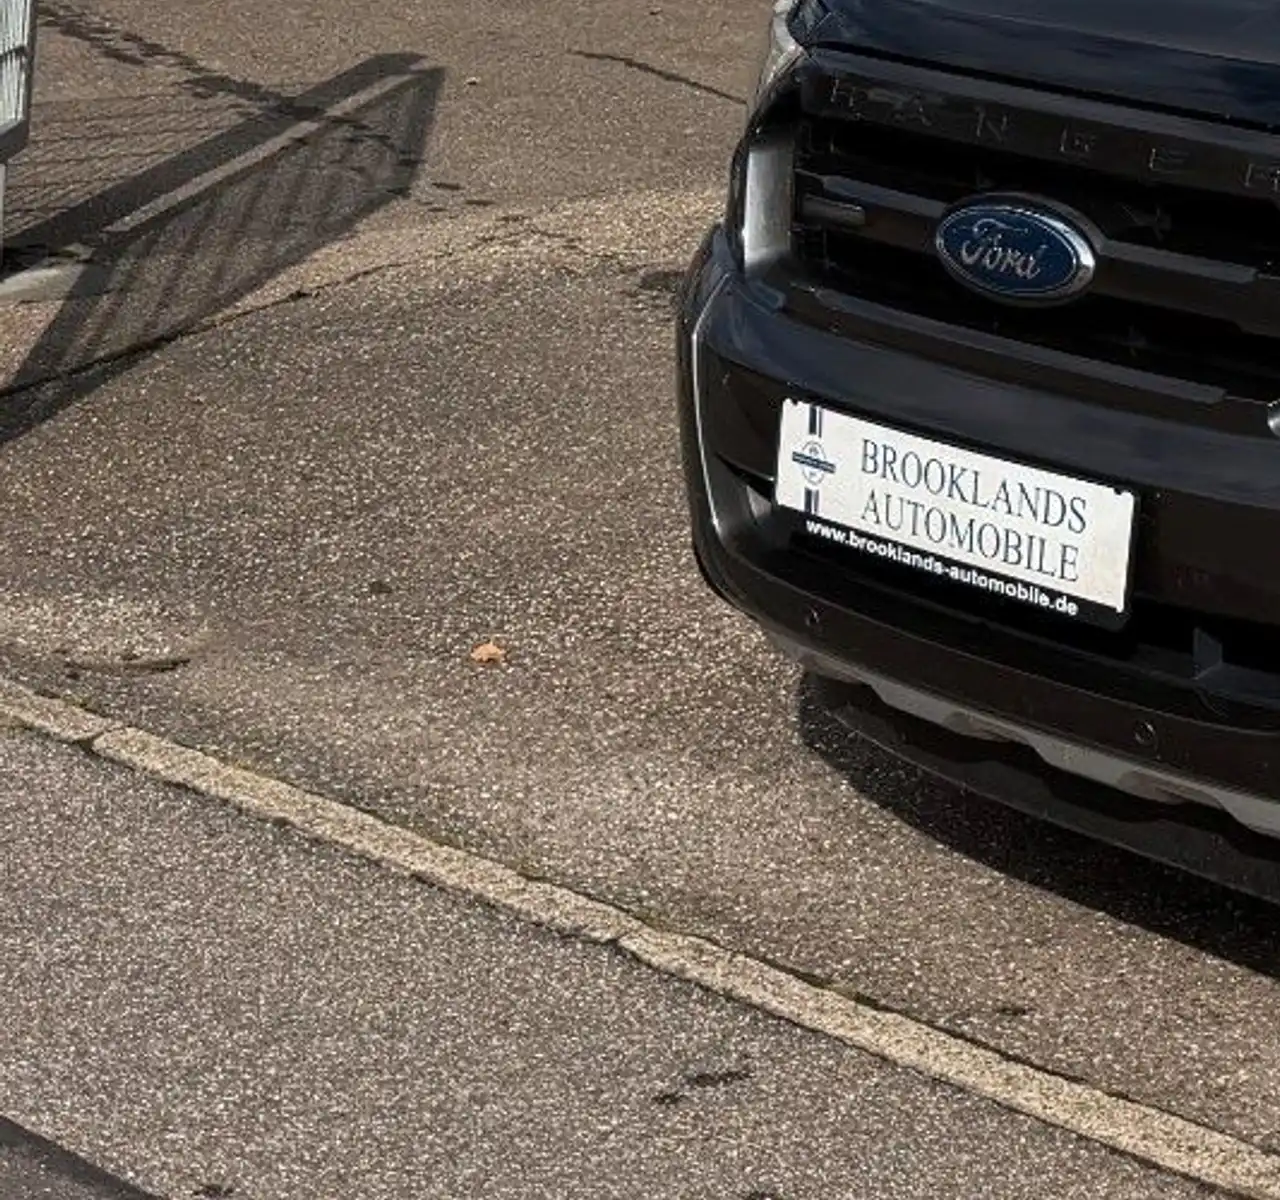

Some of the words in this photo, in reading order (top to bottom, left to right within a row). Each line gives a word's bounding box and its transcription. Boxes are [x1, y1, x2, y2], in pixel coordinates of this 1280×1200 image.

[953, 217, 1049, 280] Ford
[860, 438, 1088, 534] BROOKLANDS
[805, 518, 1080, 617] www.brooklands-automobile.de
[860, 489, 1081, 583] AUTOMOBILE
